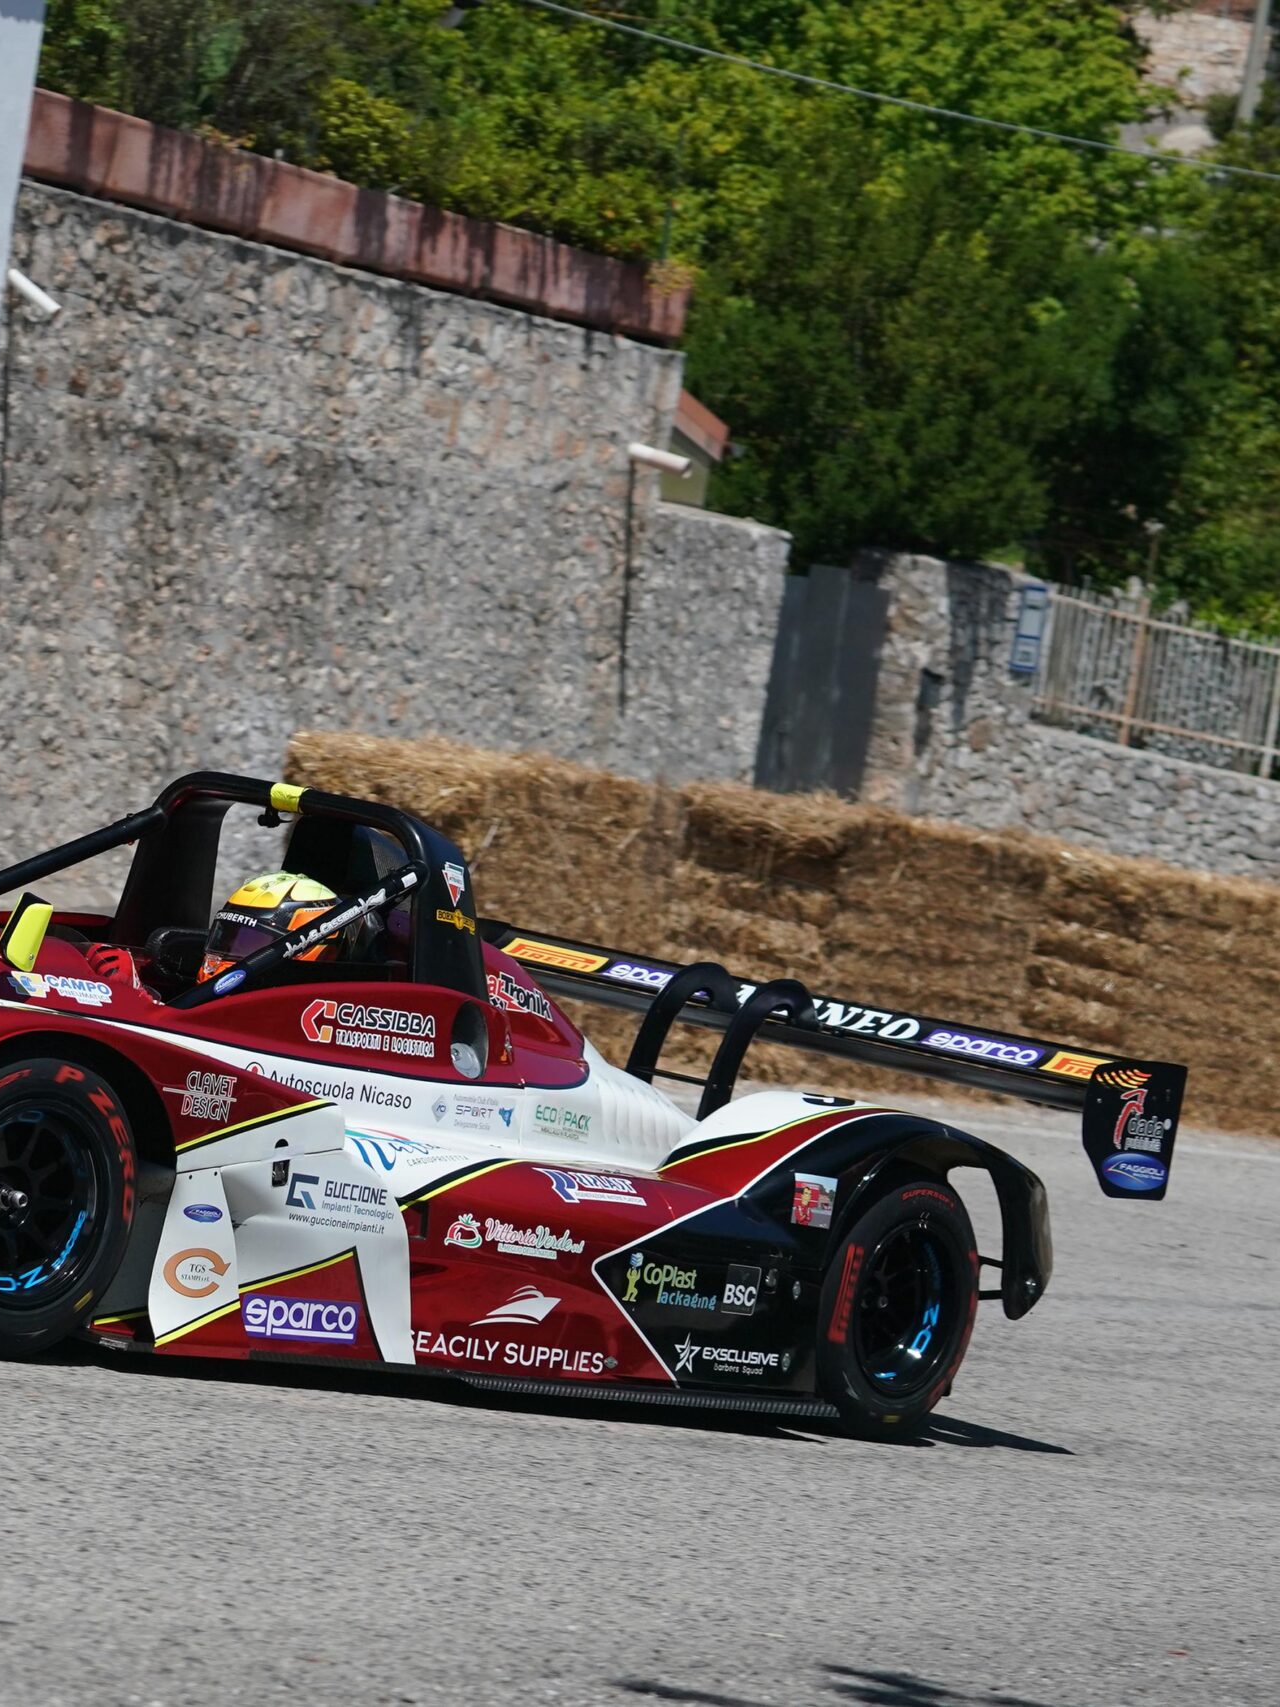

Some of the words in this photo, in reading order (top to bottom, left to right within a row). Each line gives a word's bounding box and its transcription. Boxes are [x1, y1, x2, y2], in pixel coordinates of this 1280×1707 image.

[508, 943, 597, 971] PIRELLI
[45, 975, 111, 996] CAMPO
[338, 1004, 436, 1037] CASSIBBA
[336, 1029, 381, 1050] TRASPORTI
[383, 1036, 390, 1051] E
[391, 1037, 435, 1058] LOGISTICA
[928, 1031, 1039, 1065] sparco
[53, 1064, 86, 1084] P
[186, 1070, 238, 1097] CLAVET
[270, 1070, 355, 1100] Autoscuola
[359, 1084, 412, 1109] Nicaso
[181, 1096, 232, 1123] DESIGN
[455, 1104, 494, 1118] SPORT
[564, 1111, 592, 1132] PACK
[1119, 1163, 1165, 1176] FAGGIOLI
[324, 1180, 388, 1206] GUCCIONE
[322, 1200, 352, 1214] Impianti
[352, 1204, 394, 1221] Tecnologici
[288, 1211, 385, 1235] www.guccioneimpianti.it
[189, 1263, 207, 1273] TGS
[723, 1284, 757, 1307] BSC
[245, 1298, 357, 1336] sparco
[503, 1342, 605, 1374] SUPPLIES
[702, 1347, 780, 1366] EXSCLUSIVE
[742, 1365, 763, 1376] Squad
